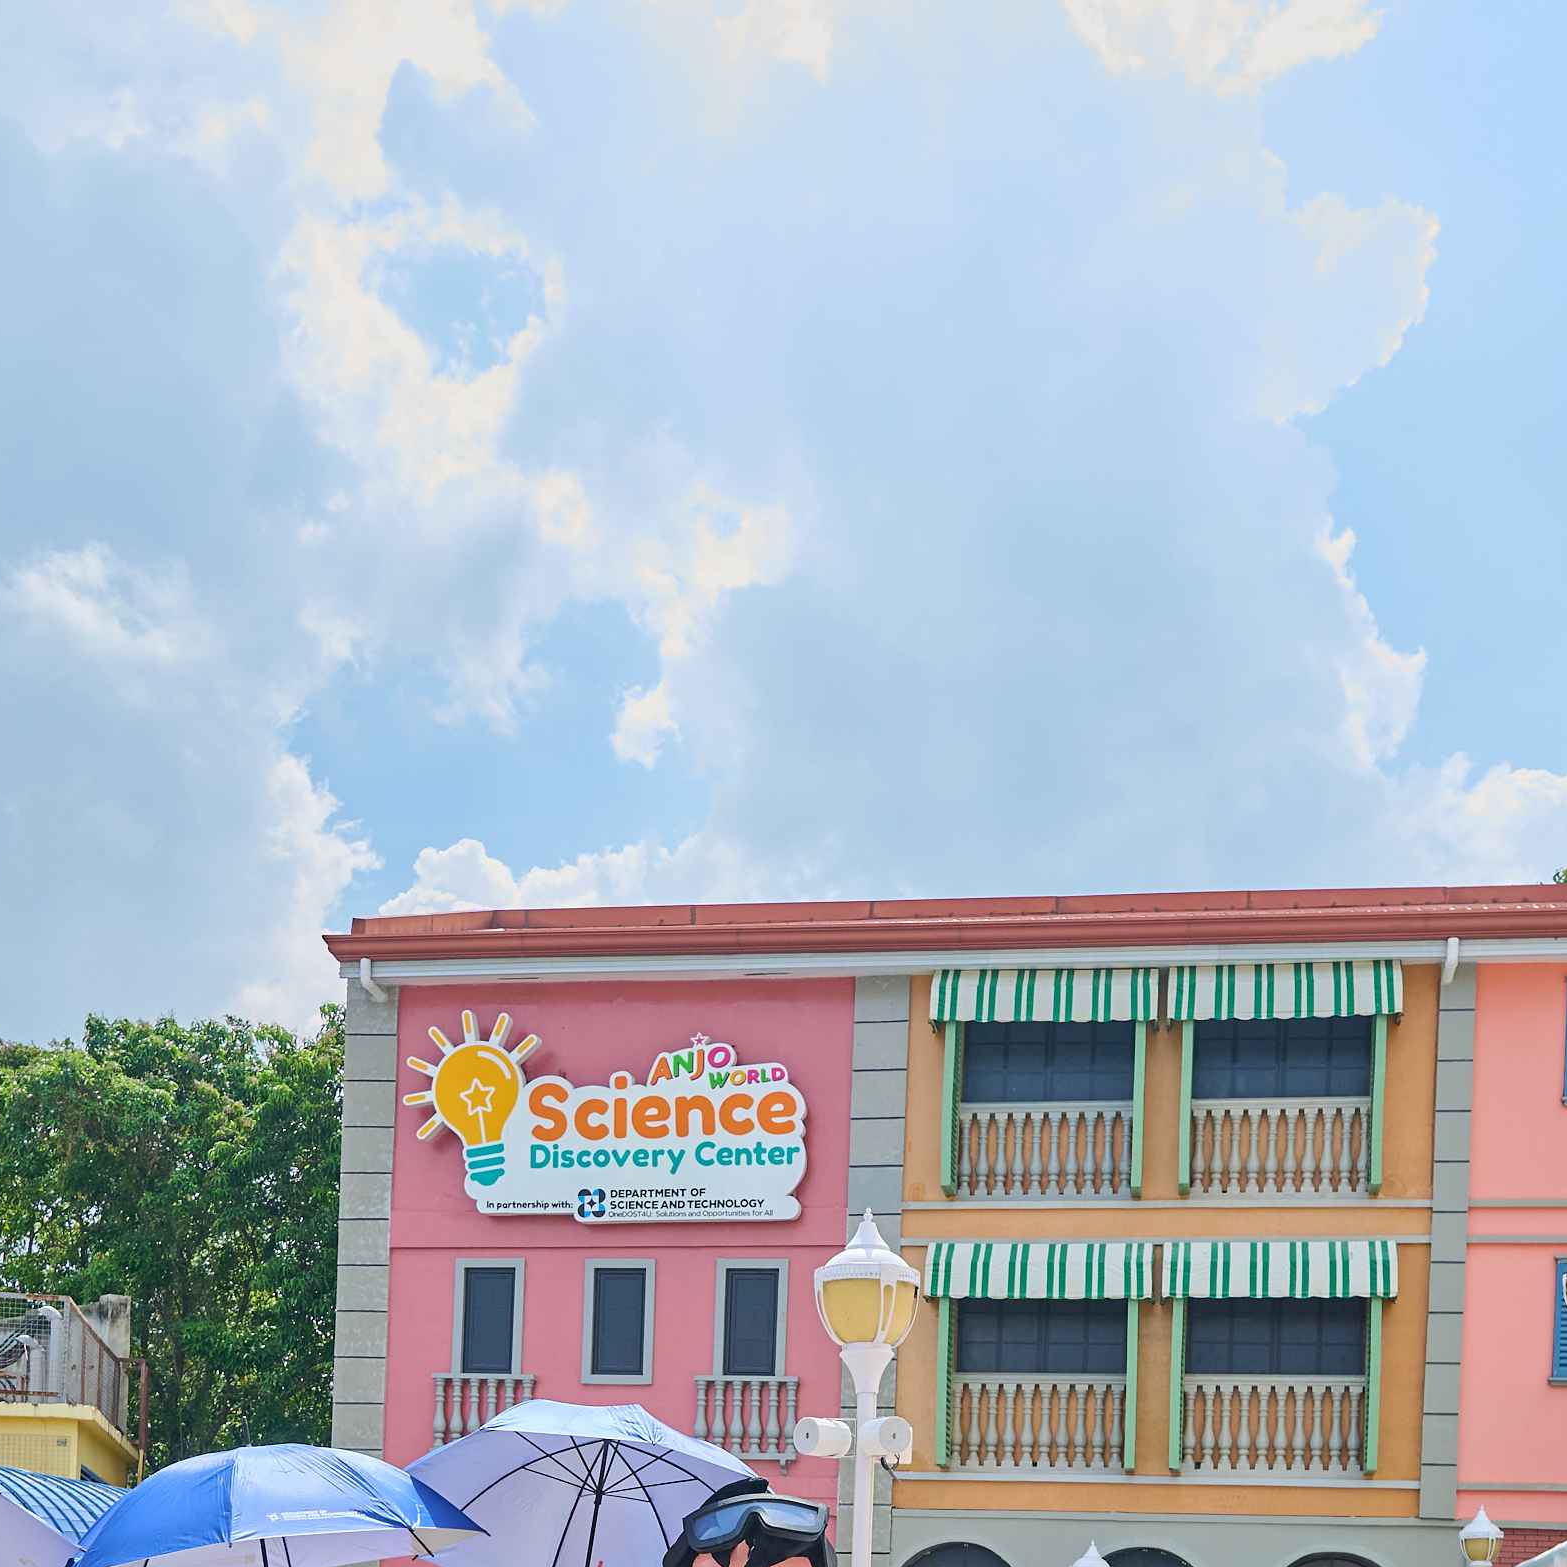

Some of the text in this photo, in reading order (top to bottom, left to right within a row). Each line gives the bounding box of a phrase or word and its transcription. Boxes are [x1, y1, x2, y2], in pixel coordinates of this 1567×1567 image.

[650, 1046, 731, 1086] ANJO
[708, 1067, 785, 1089] WORLD
[529, 1075, 797, 1141] Science
[530, 1141, 800, 1175] Discovery Center
[610, 1188, 706, 1198] DEPARTMENT OF
[486, 1199, 573, 1210] In partnership with:
[610, 1199, 765, 1210] SCIENCE AND TECHNOLOGY
[656, 1209, 687, 1217] Solutions
[688, 1209, 701, 1217] and
[702, 1209, 750, 1218] Opportunities
[752, 1209, 762, 1217] for
